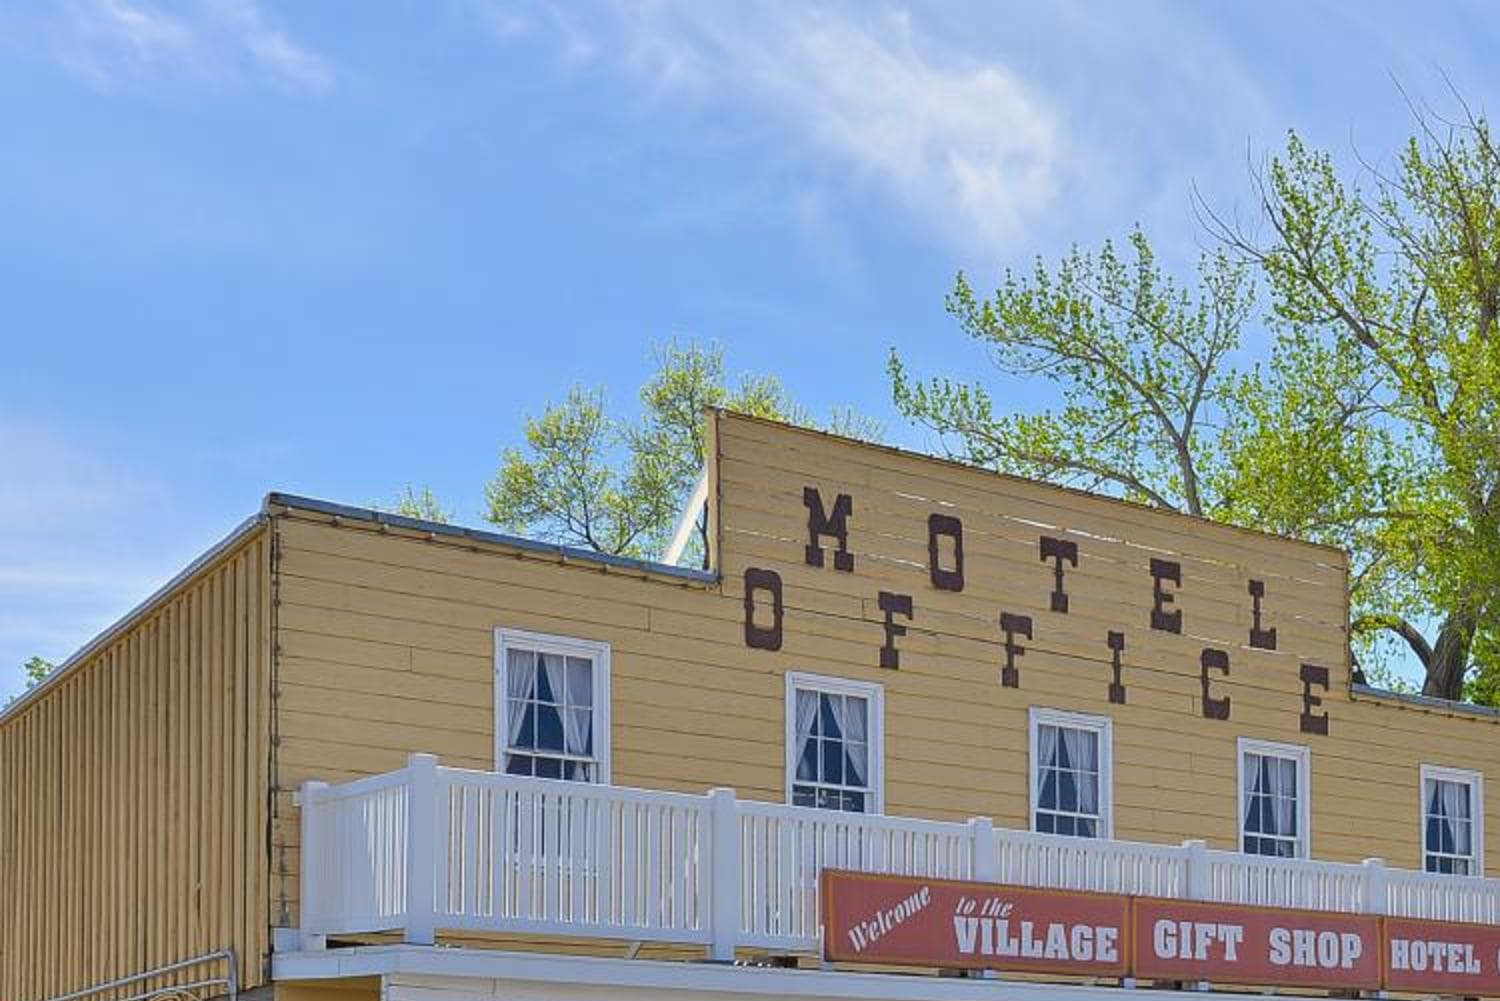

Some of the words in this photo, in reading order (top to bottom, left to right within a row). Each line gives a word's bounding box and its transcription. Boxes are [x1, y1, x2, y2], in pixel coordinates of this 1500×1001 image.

[803, 486, 1277, 650] MOTEL
[743, 567, 1329, 736] OFFICE
[848, 885, 931, 953] Welcome
[955, 896, 974, 915] to
[980, 897, 1013, 917] the
[953, 915, 1118, 962] VILLAGE
[1153, 919, 1244, 961] GIFT
[1268, 927, 1363, 969] SHOP
[1390, 939, 1481, 975] HOTEL
